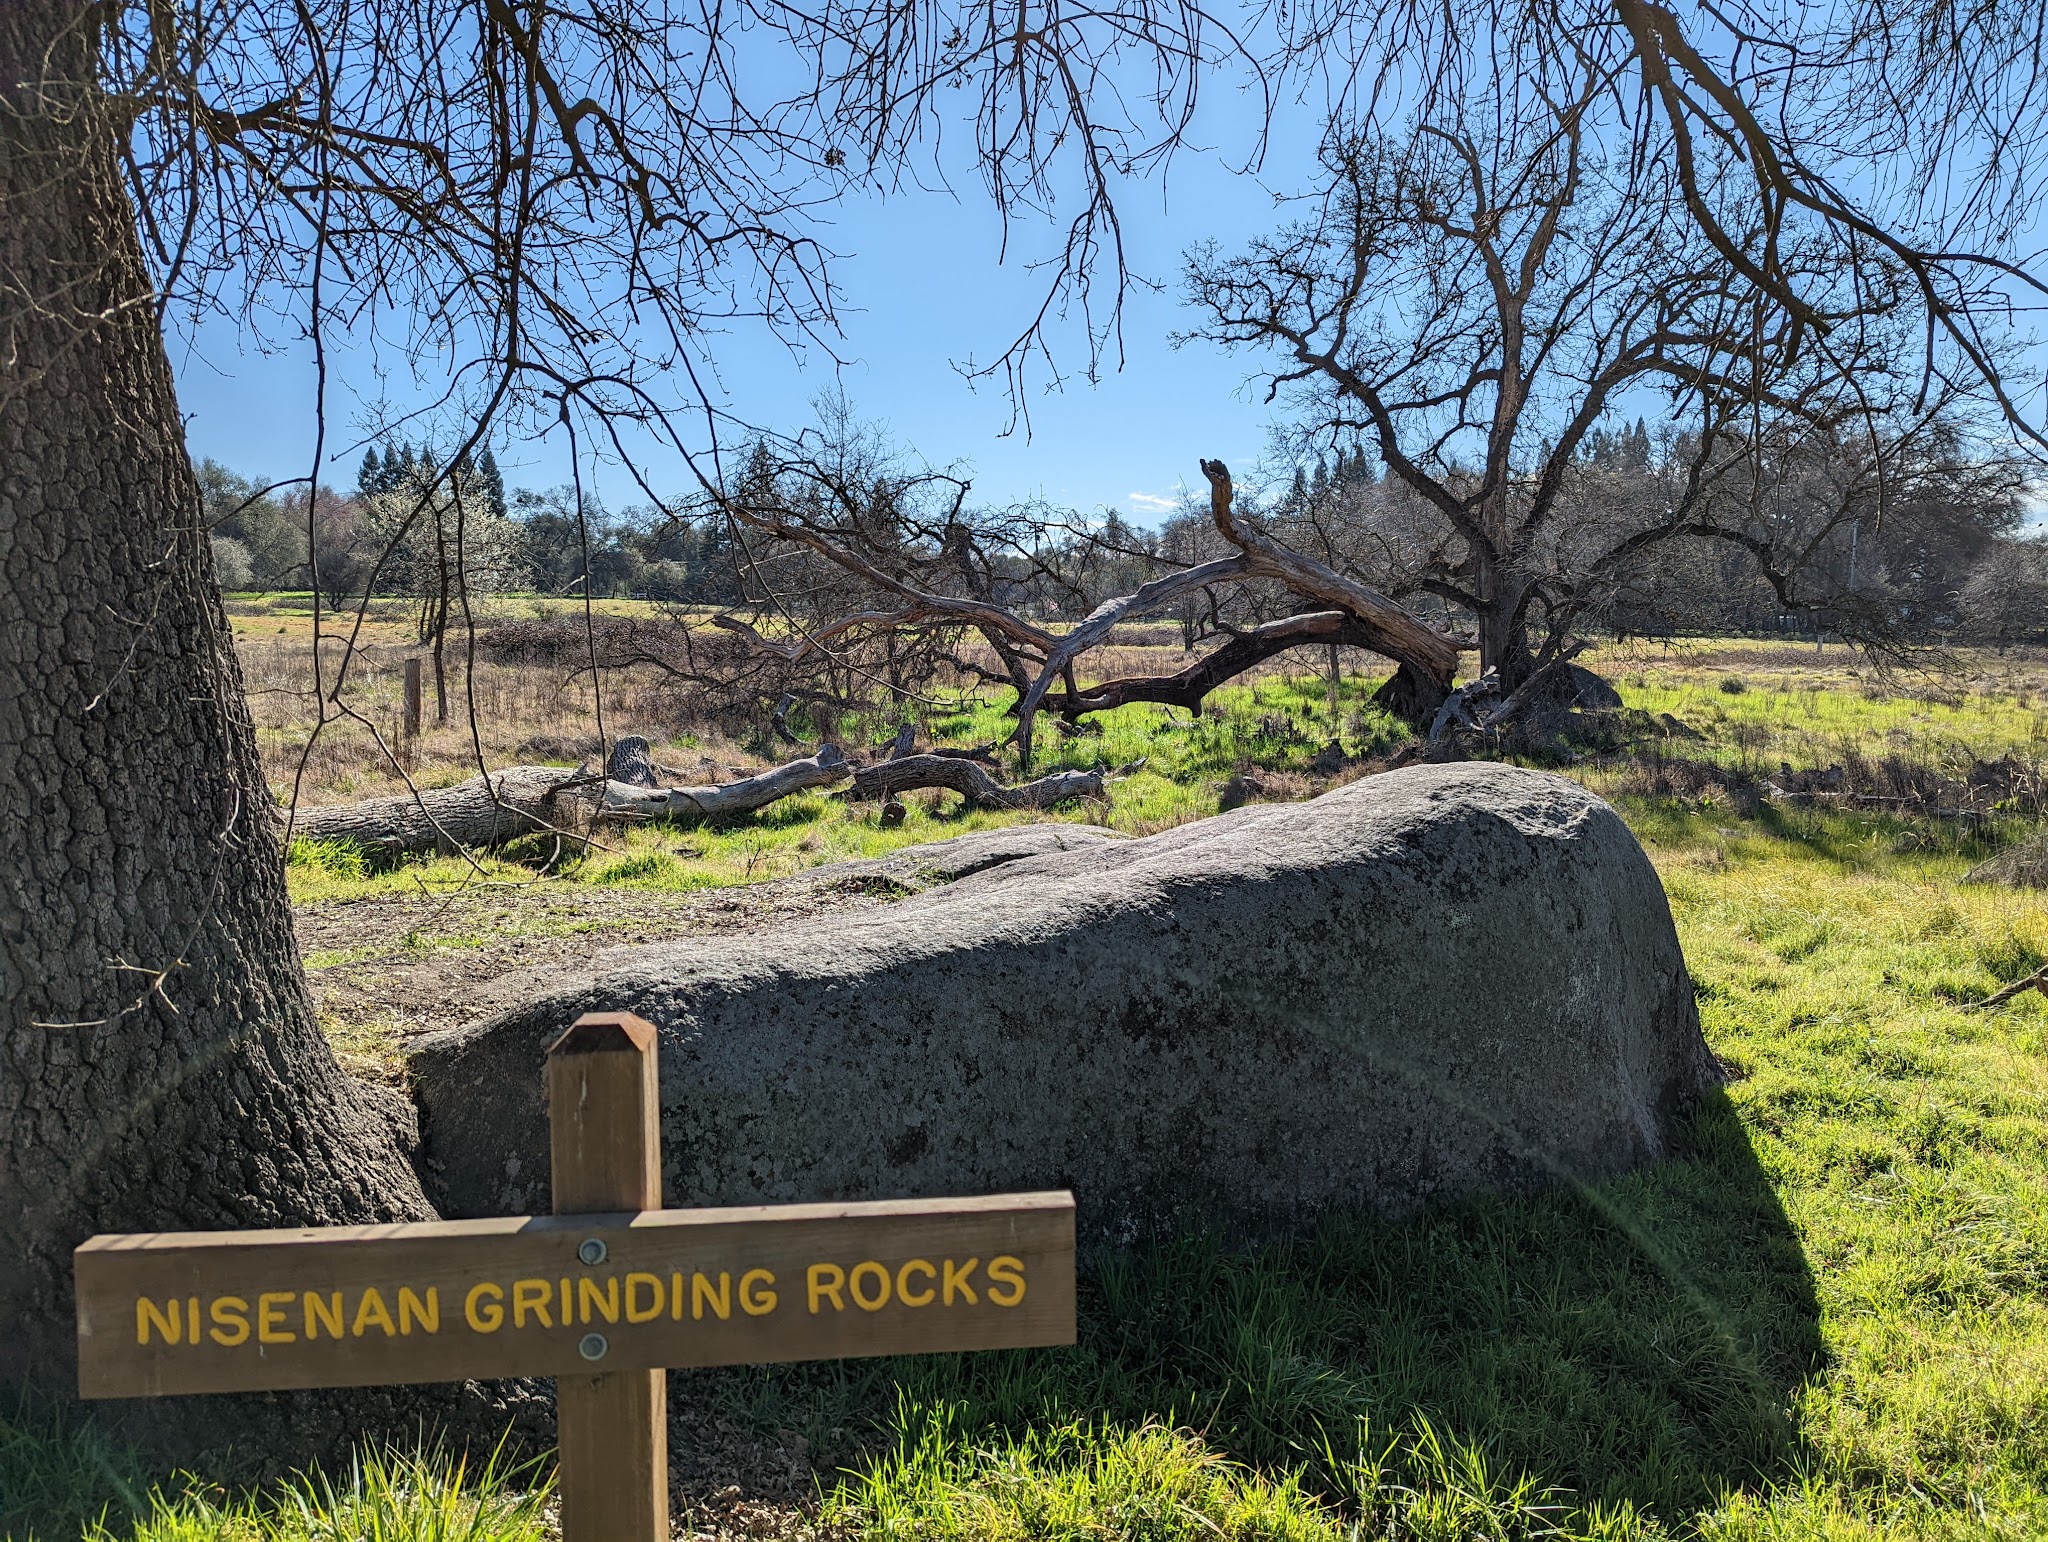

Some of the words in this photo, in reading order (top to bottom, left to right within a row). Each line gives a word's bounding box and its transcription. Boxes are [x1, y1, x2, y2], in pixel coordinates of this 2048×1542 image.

[136, 1287, 440, 1346] NISENAN
[464, 1269, 778, 1333] GRINDING
[806, 1256, 1027, 1313] ROCKS
